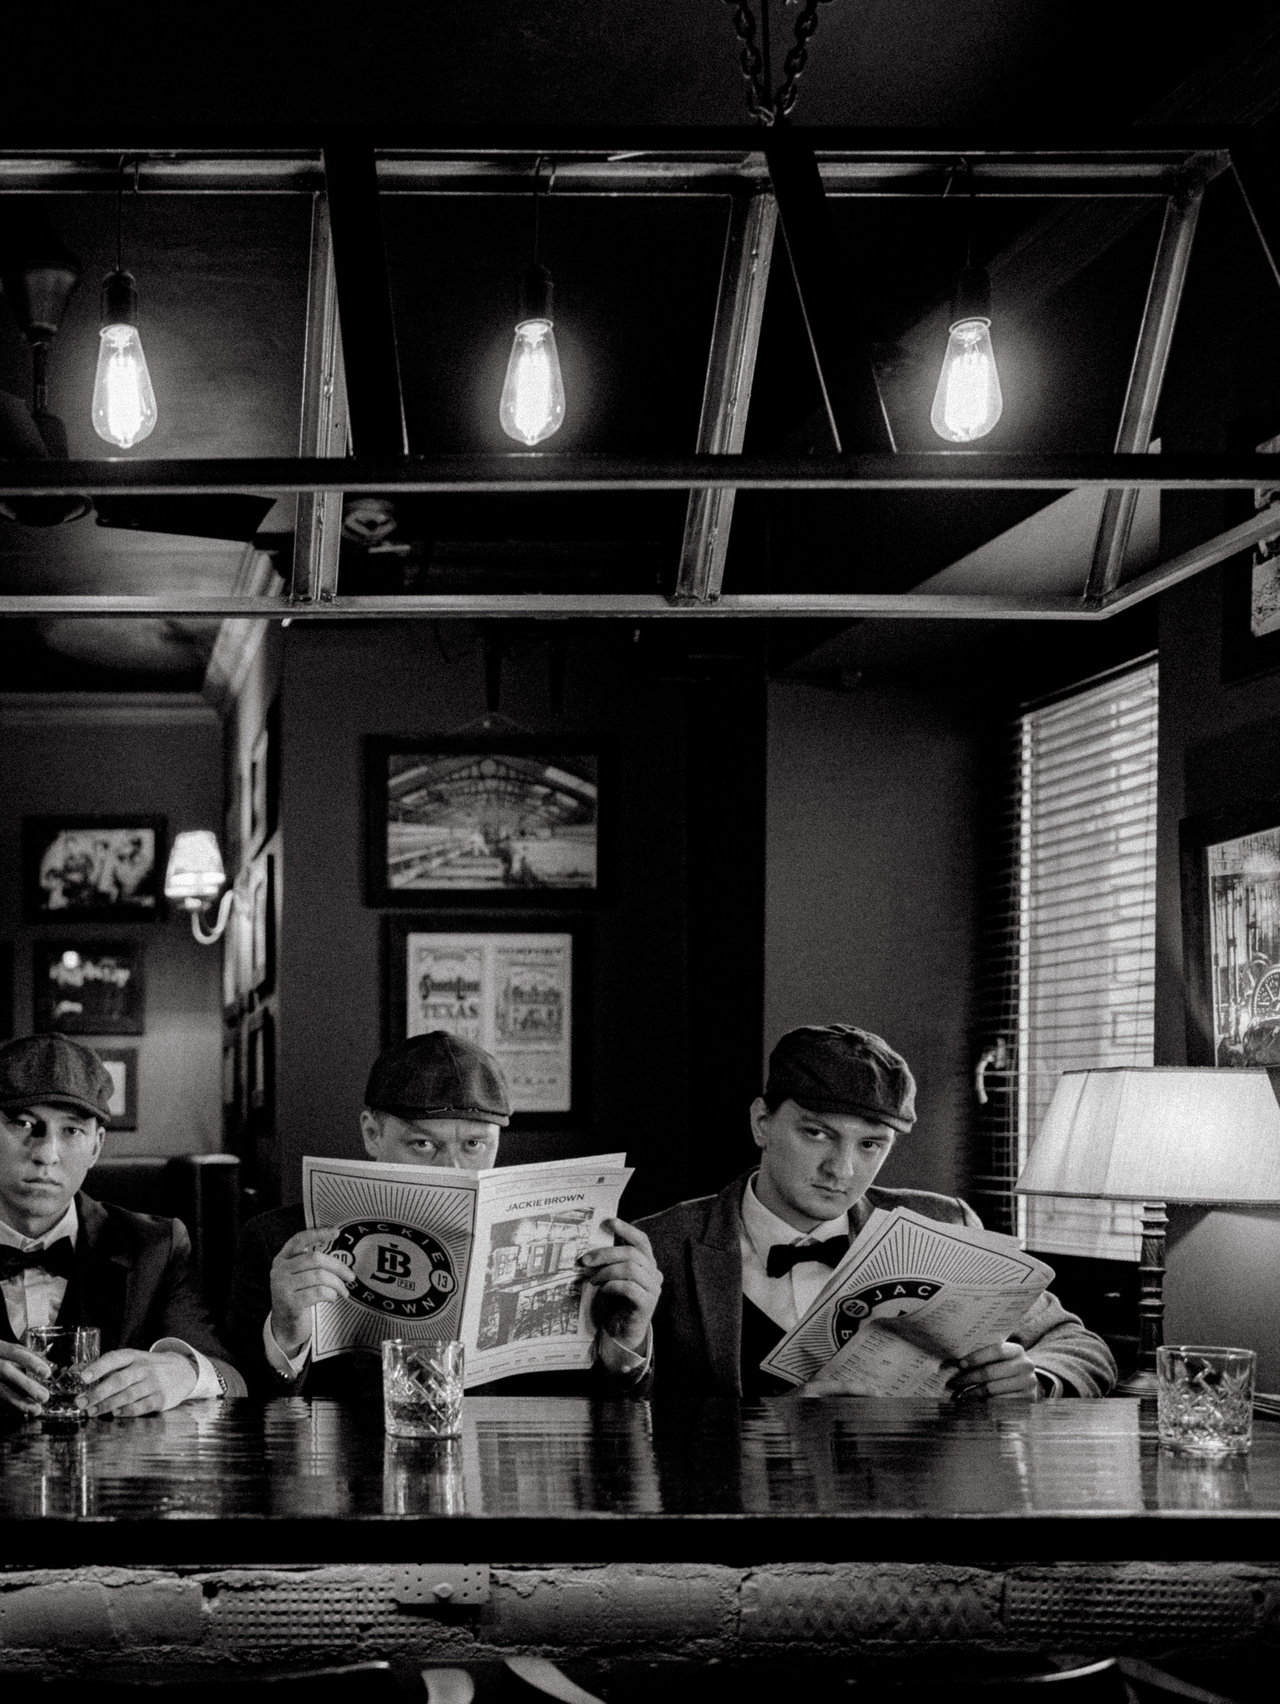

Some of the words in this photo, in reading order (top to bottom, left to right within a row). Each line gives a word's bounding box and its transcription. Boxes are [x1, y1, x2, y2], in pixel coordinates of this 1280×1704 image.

[422, 1003, 479, 1019] TEXAS
[506, 1199, 542, 1212] JACKIE
[544, 1193, 585, 1206] BROWN
[344, 1223, 445, 1264] JACKIE
[437, 1273, 448, 1289] 13
[345, 1280, 436, 1314] BROWN
[846, 1301, 866, 1316] 20
